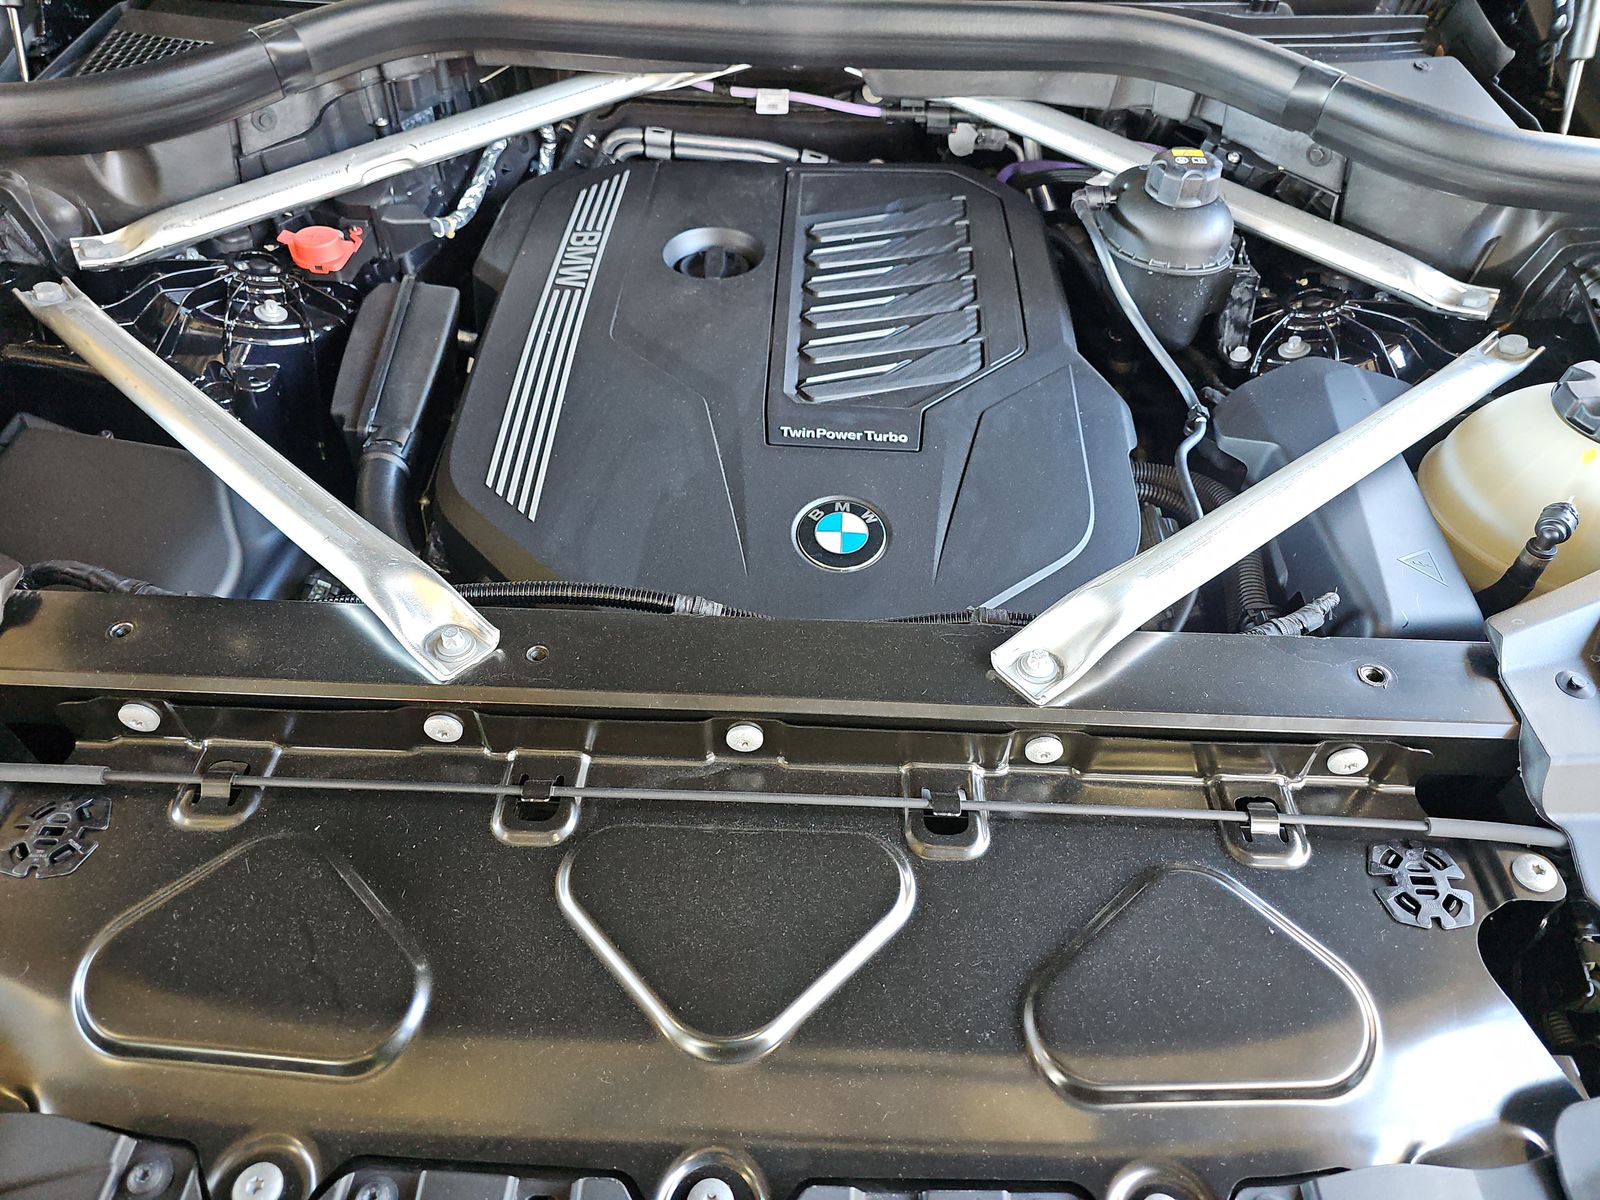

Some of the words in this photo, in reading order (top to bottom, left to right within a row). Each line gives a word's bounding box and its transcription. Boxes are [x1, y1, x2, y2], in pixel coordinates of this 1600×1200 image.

[555, 231, 602, 288] BMW
[780, 426, 863, 441] TwinPower
[864, 430, 908, 443] Turbo
[808, 502, 878, 524] BMW
